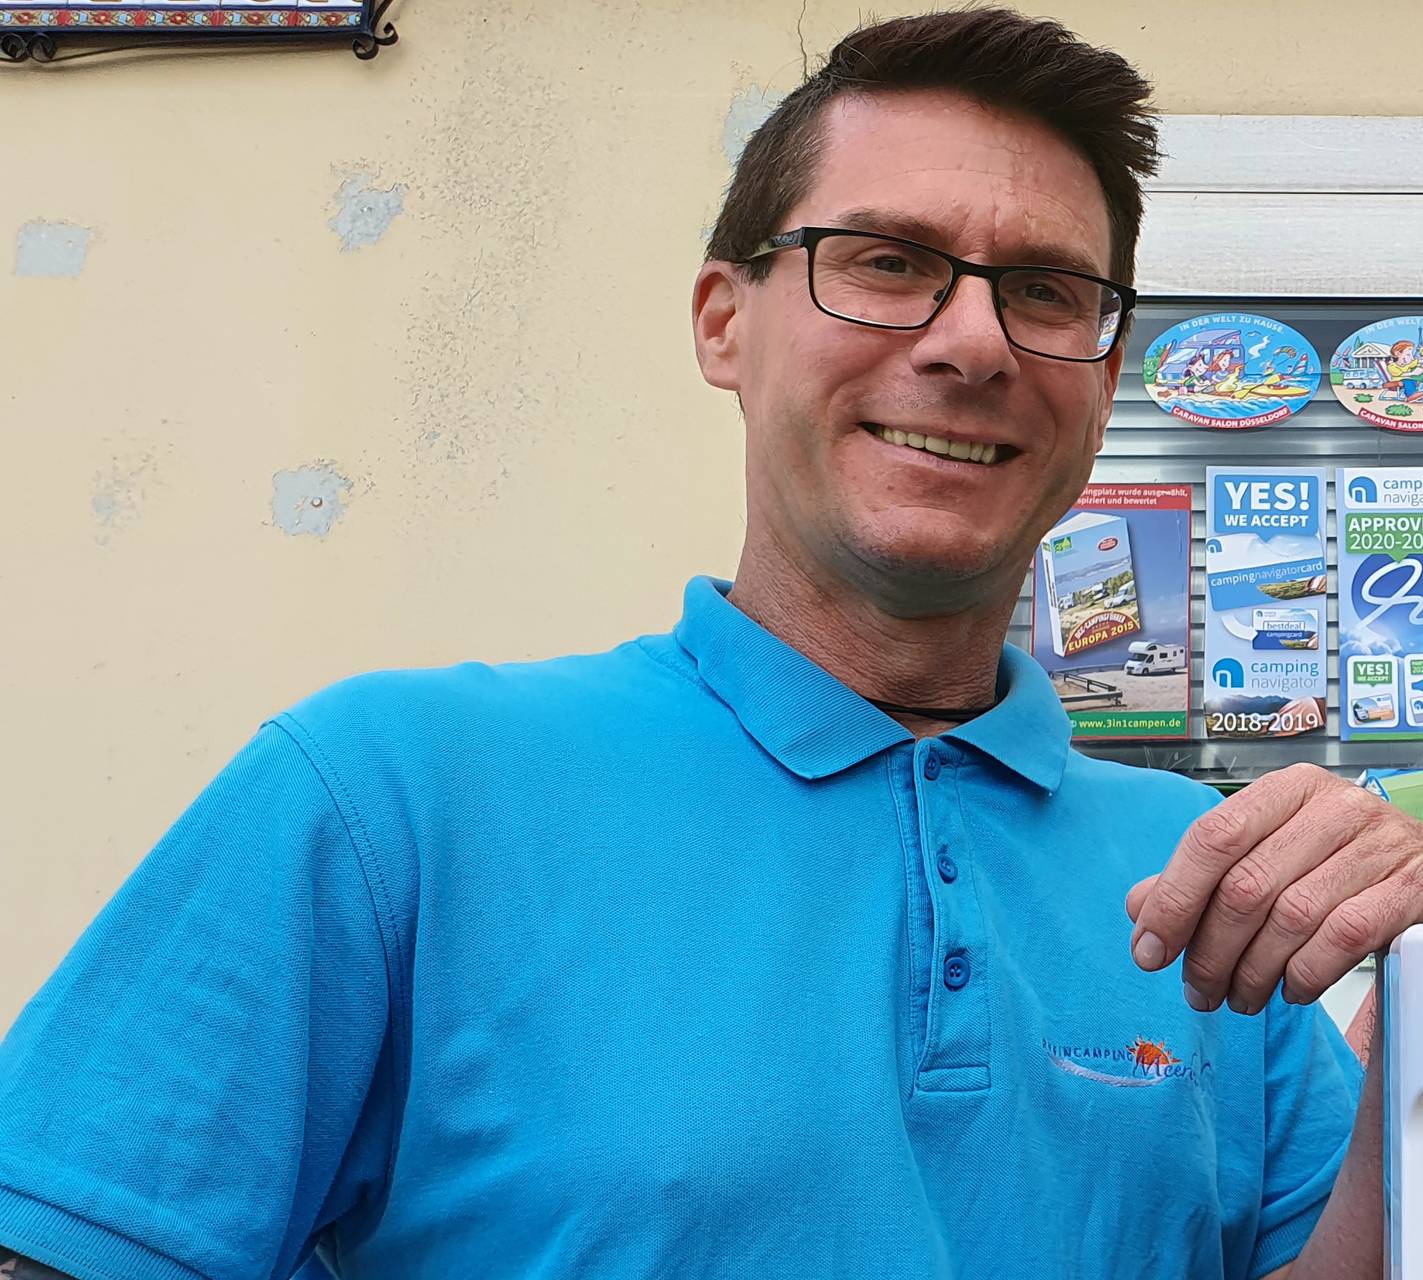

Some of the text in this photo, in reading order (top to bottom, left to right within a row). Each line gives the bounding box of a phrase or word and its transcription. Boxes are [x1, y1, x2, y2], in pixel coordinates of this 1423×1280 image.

[1192, 318, 1209, 329] DER
[1212, 316, 1237, 324] WELT
[1239, 316, 1251, 324] ZU
[1398, 318, 1423, 326] WELT
[1172, 407, 1290, 428] CARAVAN SALON DÜSSELDORF
[1360, 410, 1397, 428] CARAVAN
[1117, 488, 1142, 497] wurde
[1143, 488, 1188, 498] ausgewählt,
[1224, 481, 1310, 511] YES!
[1107, 496, 1122, 505] und
[1123, 496, 1157, 506] bewertet
[1224, 514, 1309, 527] WE ACCEPT
[1211, 561, 1323, 587] campingnavigatorcard
[1266, 621, 1302, 631] bestdeal
[1068, 630, 1108, 652] EUROPA
[1111, 620, 1135, 636] 2015
[1250, 659, 1320, 677] camping
[1356, 663, 1390, 676] YES!
[1251, 675, 1317, 692] navigator
[1078, 717, 1181, 730] www.3in1campen.de
[1211, 712, 1319, 732] 2018-2019
